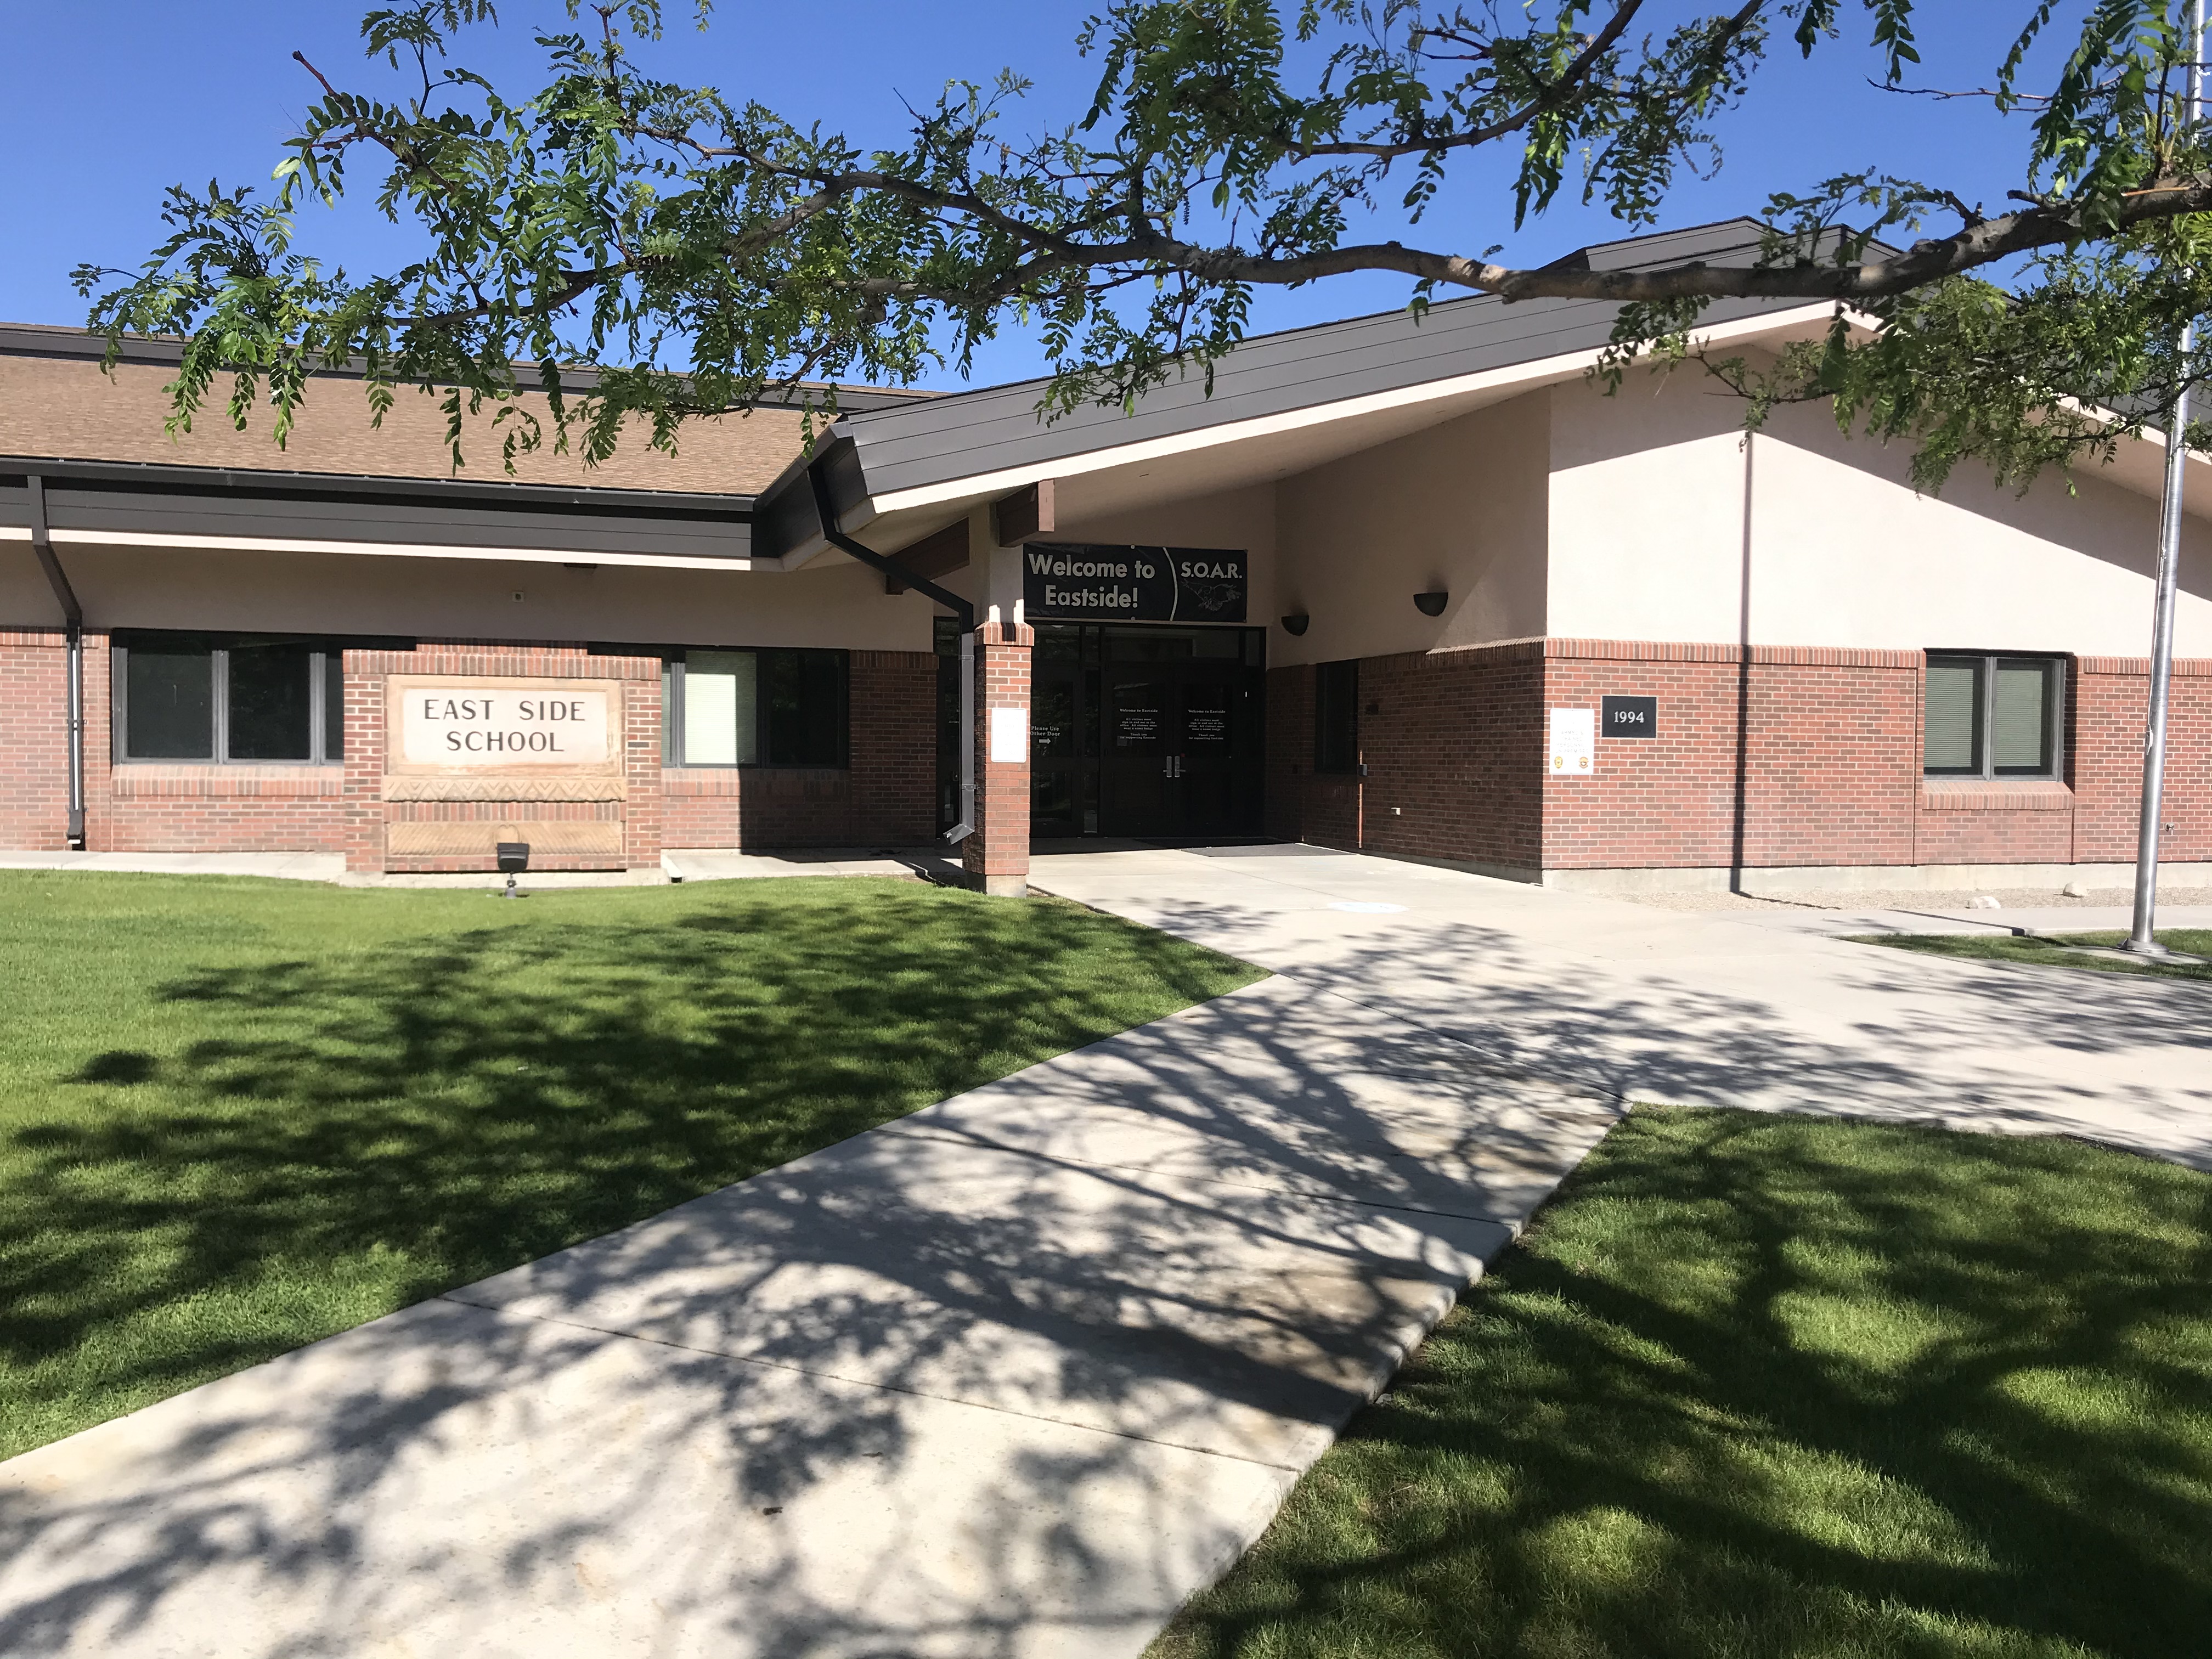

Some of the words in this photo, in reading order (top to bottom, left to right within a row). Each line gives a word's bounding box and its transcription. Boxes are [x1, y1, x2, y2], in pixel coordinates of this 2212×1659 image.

[1028, 554, 1127, 578] Welcome
[1135, 560, 1155, 579] to
[1181, 562, 1242, 579] S.O.A.R.
[1045, 585, 1138, 608] Eastside!
[425, 699, 495, 720] EAST
[519, 701, 585, 721] SIDE
[1614, 712, 1644, 723] 1994
[447, 731, 565, 752] SCHOOL
